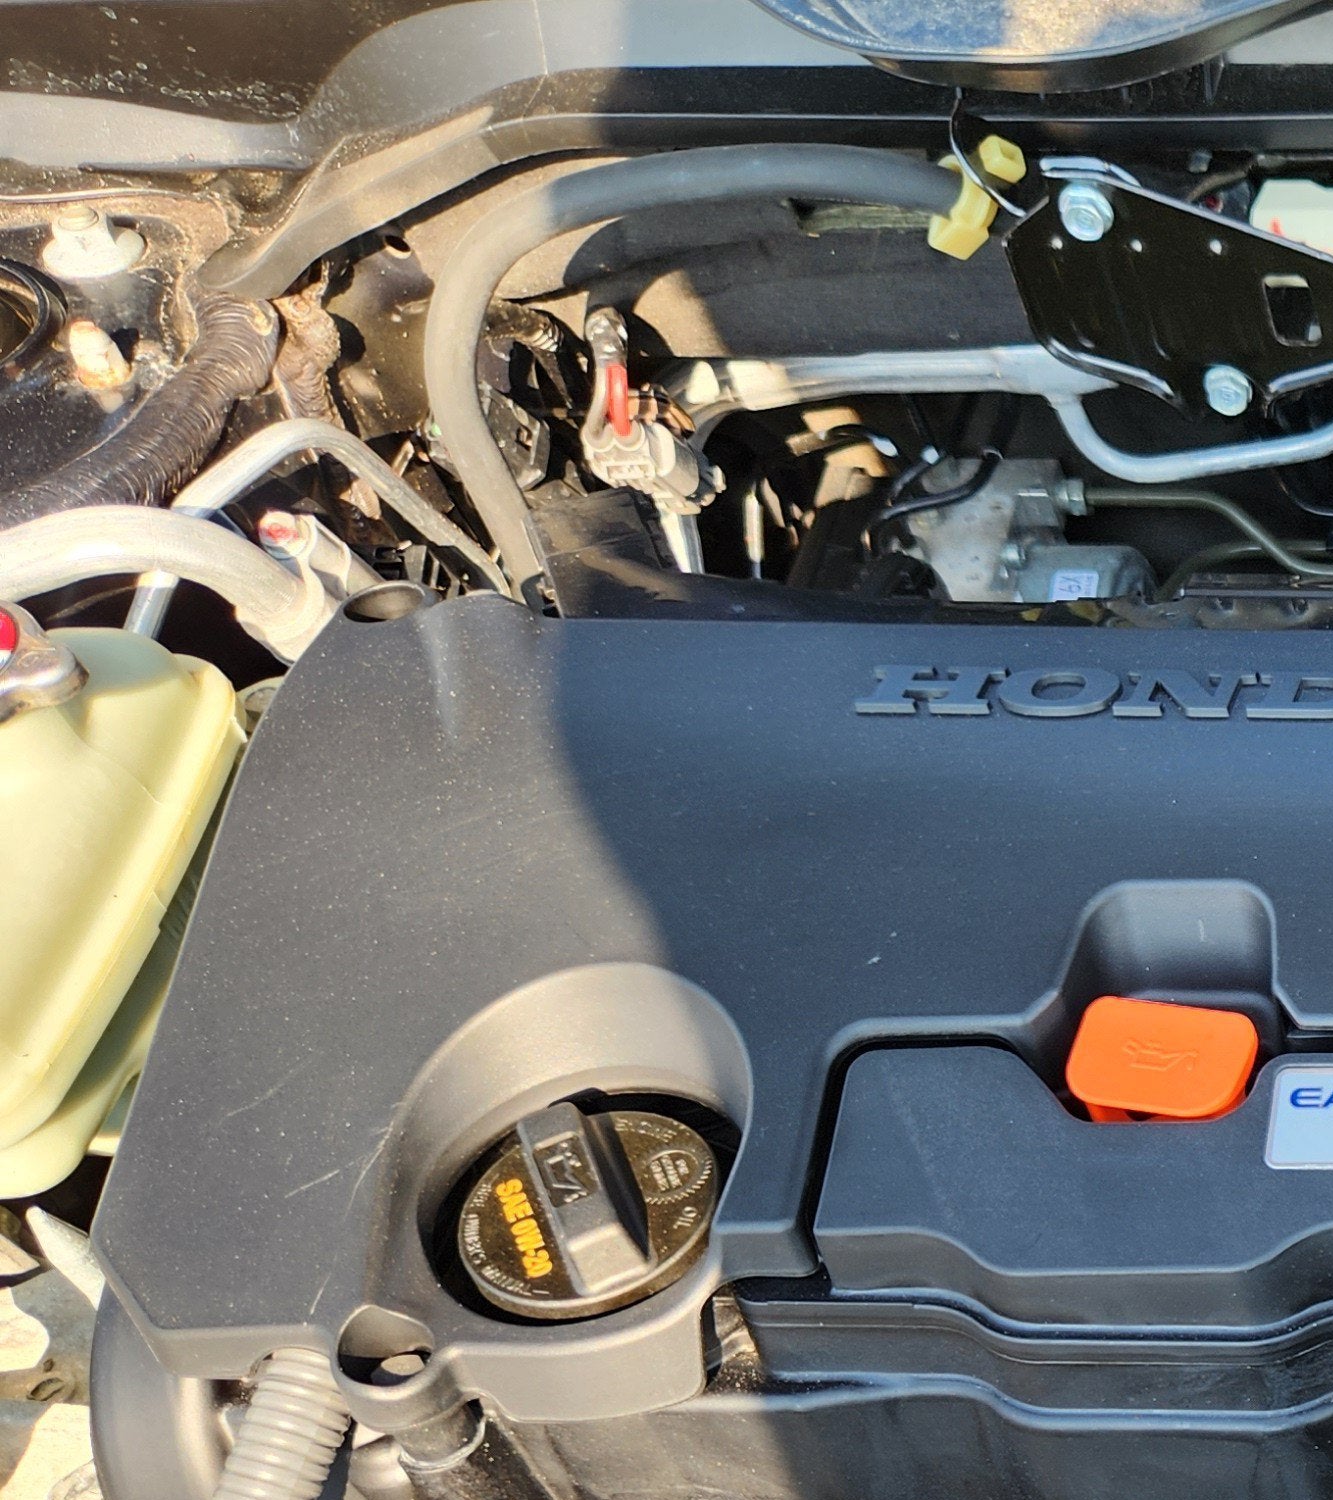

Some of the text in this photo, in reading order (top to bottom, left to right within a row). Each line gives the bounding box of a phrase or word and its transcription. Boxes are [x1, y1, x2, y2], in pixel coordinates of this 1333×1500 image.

[496, 1178, 553, 1278] SAE 0W-20
[673, 1206, 698, 1229] OIL
